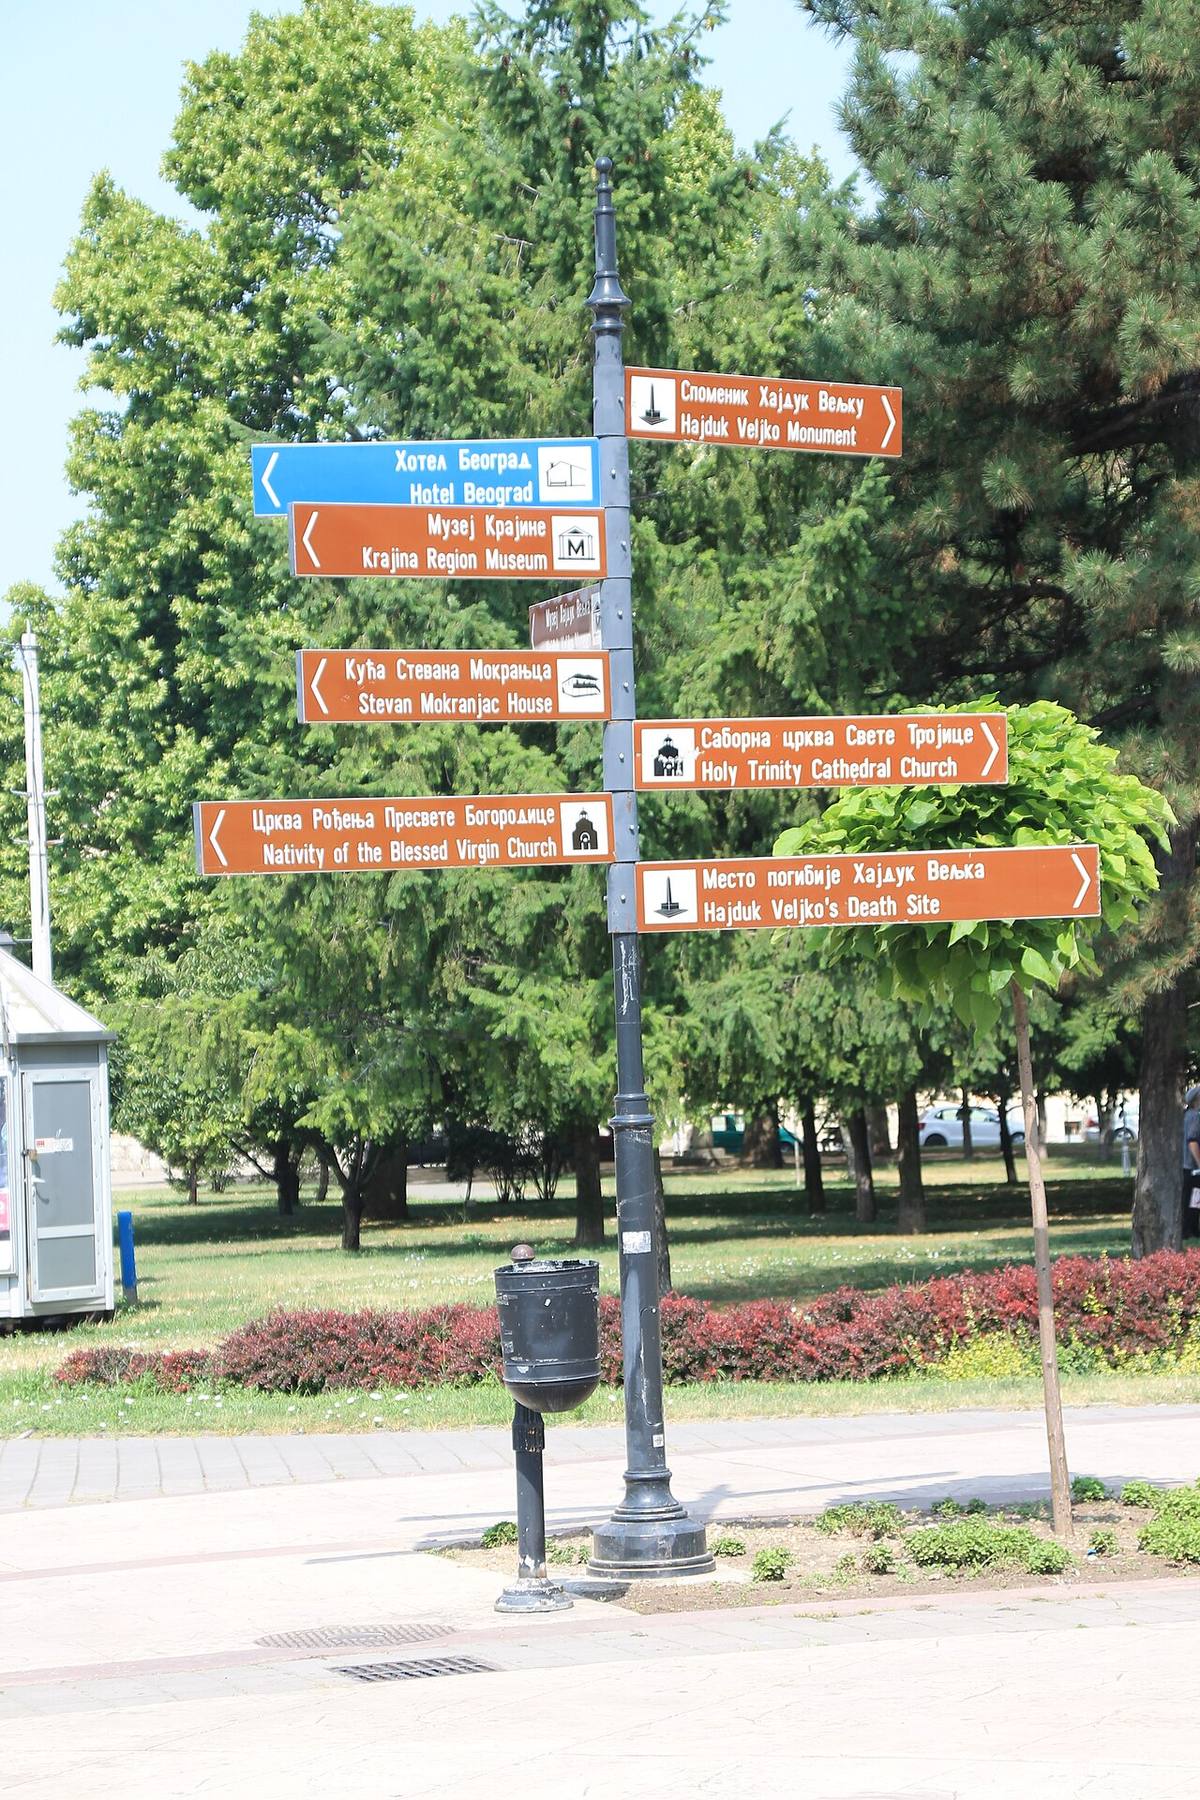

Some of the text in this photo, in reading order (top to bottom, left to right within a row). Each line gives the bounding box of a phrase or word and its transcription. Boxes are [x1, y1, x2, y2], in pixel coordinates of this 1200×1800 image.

[681, 380, 863, 418] Споменик Хајдук Вељку
[681, 413, 856, 446] Hajduk Veljko Monument
[396, 449, 531, 474] Хотел Београд
[409, 481, 533, 507] Hotel Beograd
[428, 514, 546, 541] Музеј Крајине
[363, 547, 547, 574] Krajina Region Museum
[346, 659, 551, 685] Кућа Стевана Мокрањца
[359, 693, 552, 718] Stevan Mokranjac House
[702, 724, 973, 753] Саборна црква Свете Тројице
[702, 757, 957, 786] Holy Trinity Cathedral Church
[253, 805, 554, 835] Црква Рођења Пресвете Богородице
[264, 837, 557, 869] Nativity of the Blessed Virgin Church
[703, 860, 984, 890] Место погибије Хајдук Вељка
[704, 894, 939, 927] Hajduk Veljko's Death Site
